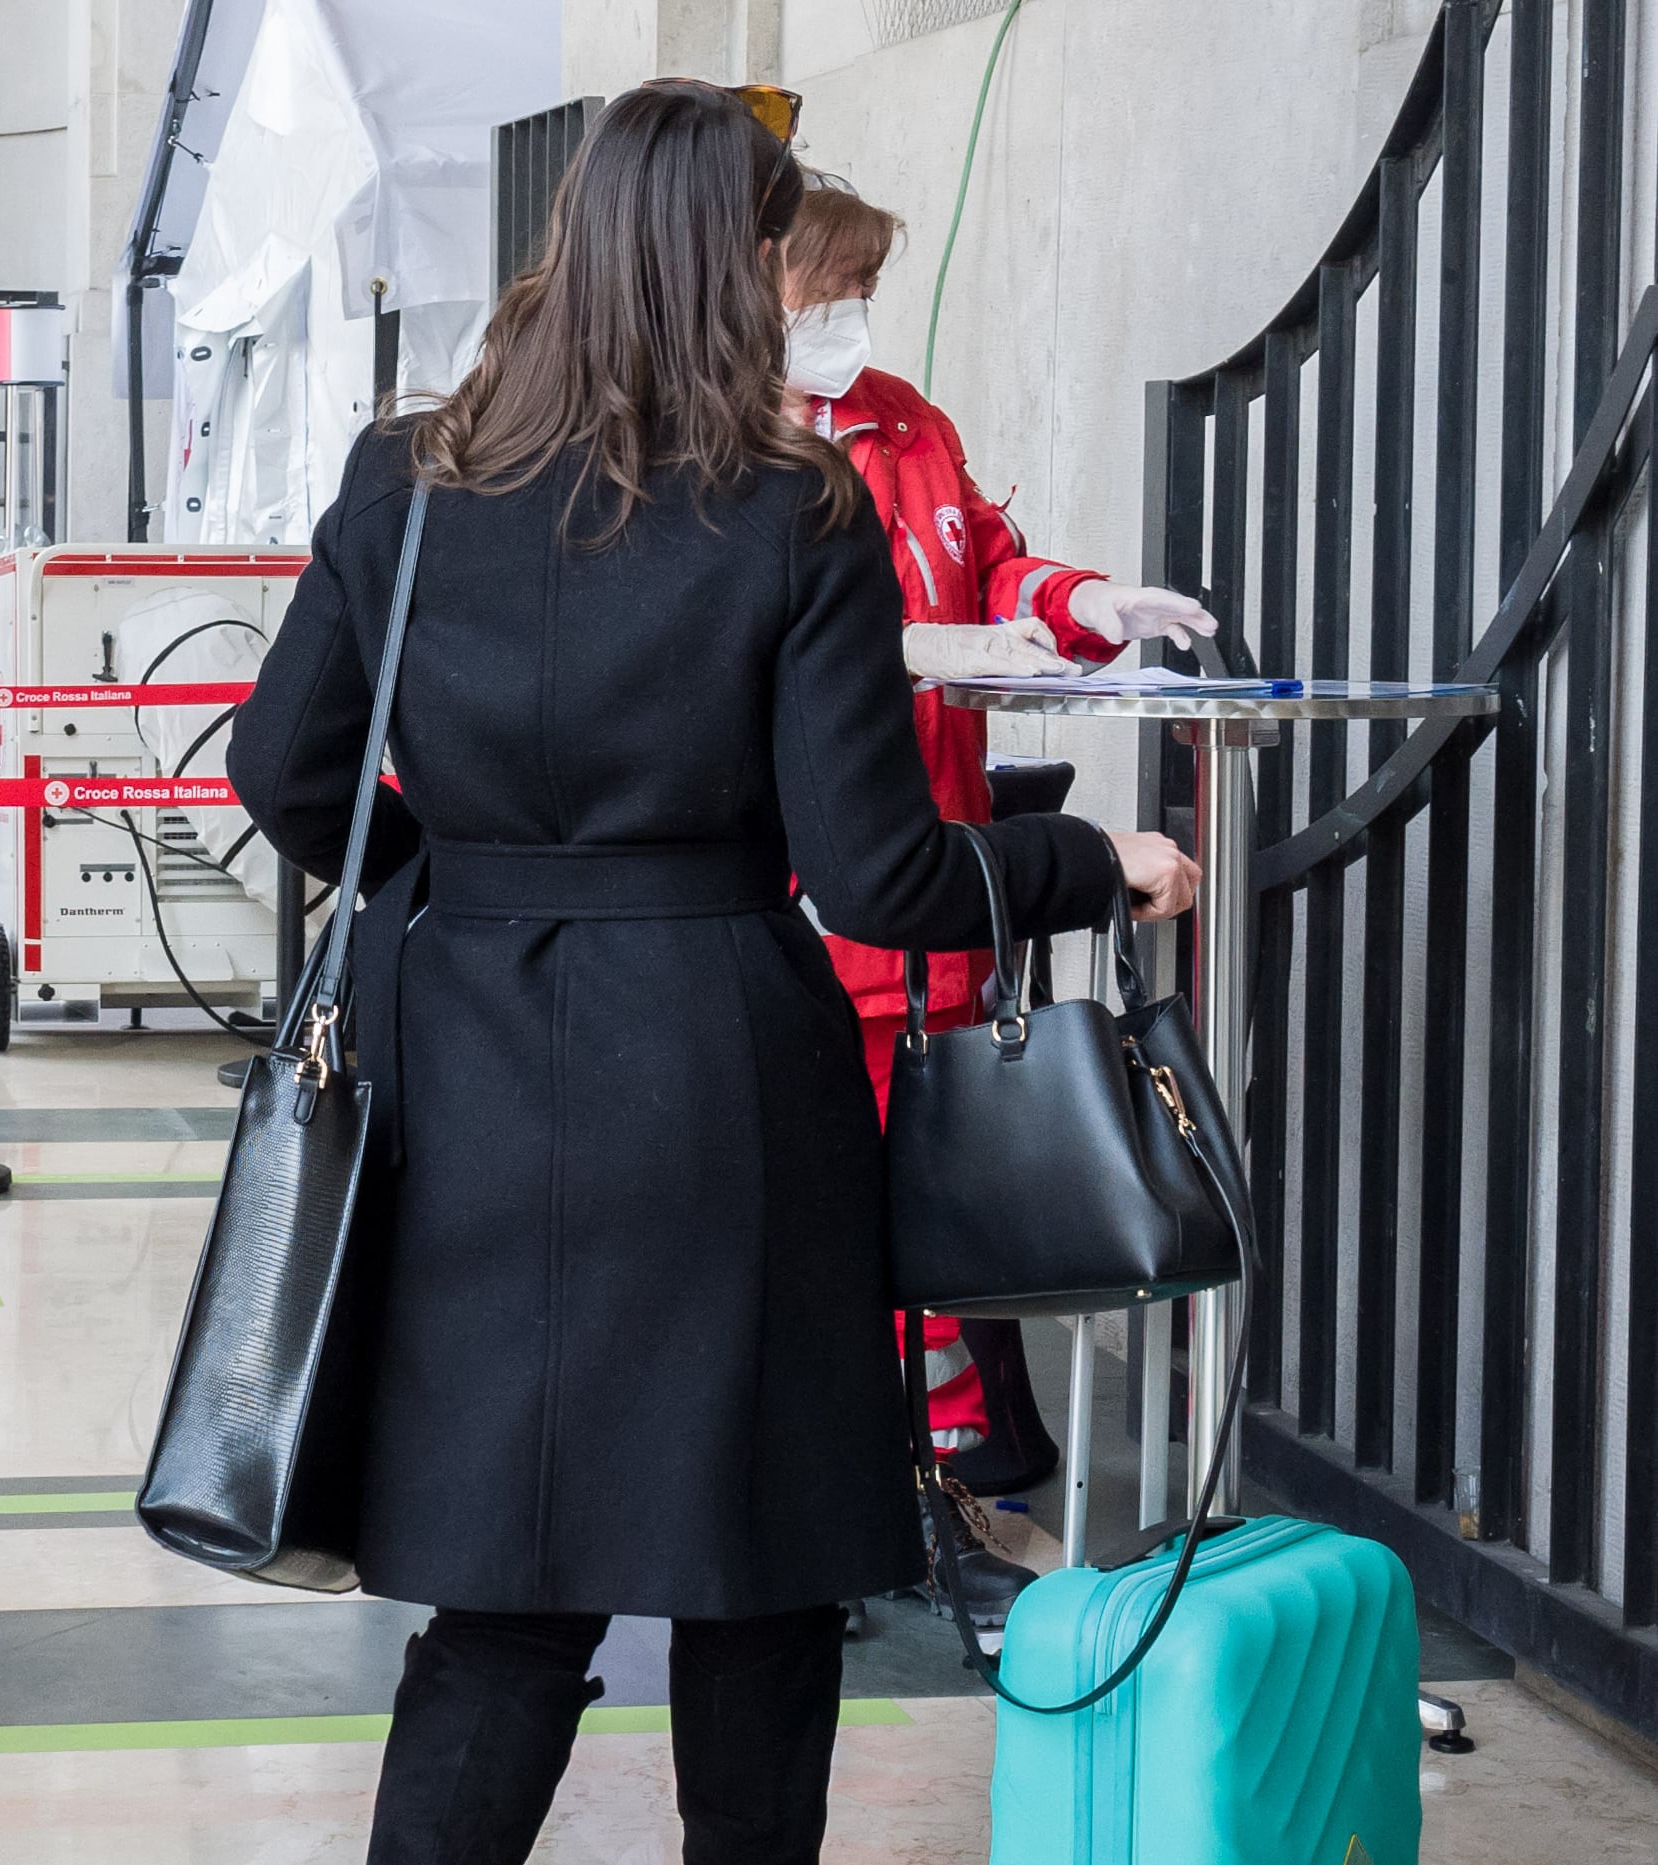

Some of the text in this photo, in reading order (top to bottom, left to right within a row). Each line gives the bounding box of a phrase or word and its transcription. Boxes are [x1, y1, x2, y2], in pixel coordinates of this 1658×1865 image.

[15, 689, 132, 703] Croce Rossa Italiana
[73, 785, 228, 800] Croce Rossa Italiana
[60, 907, 124, 916] Dantherm
